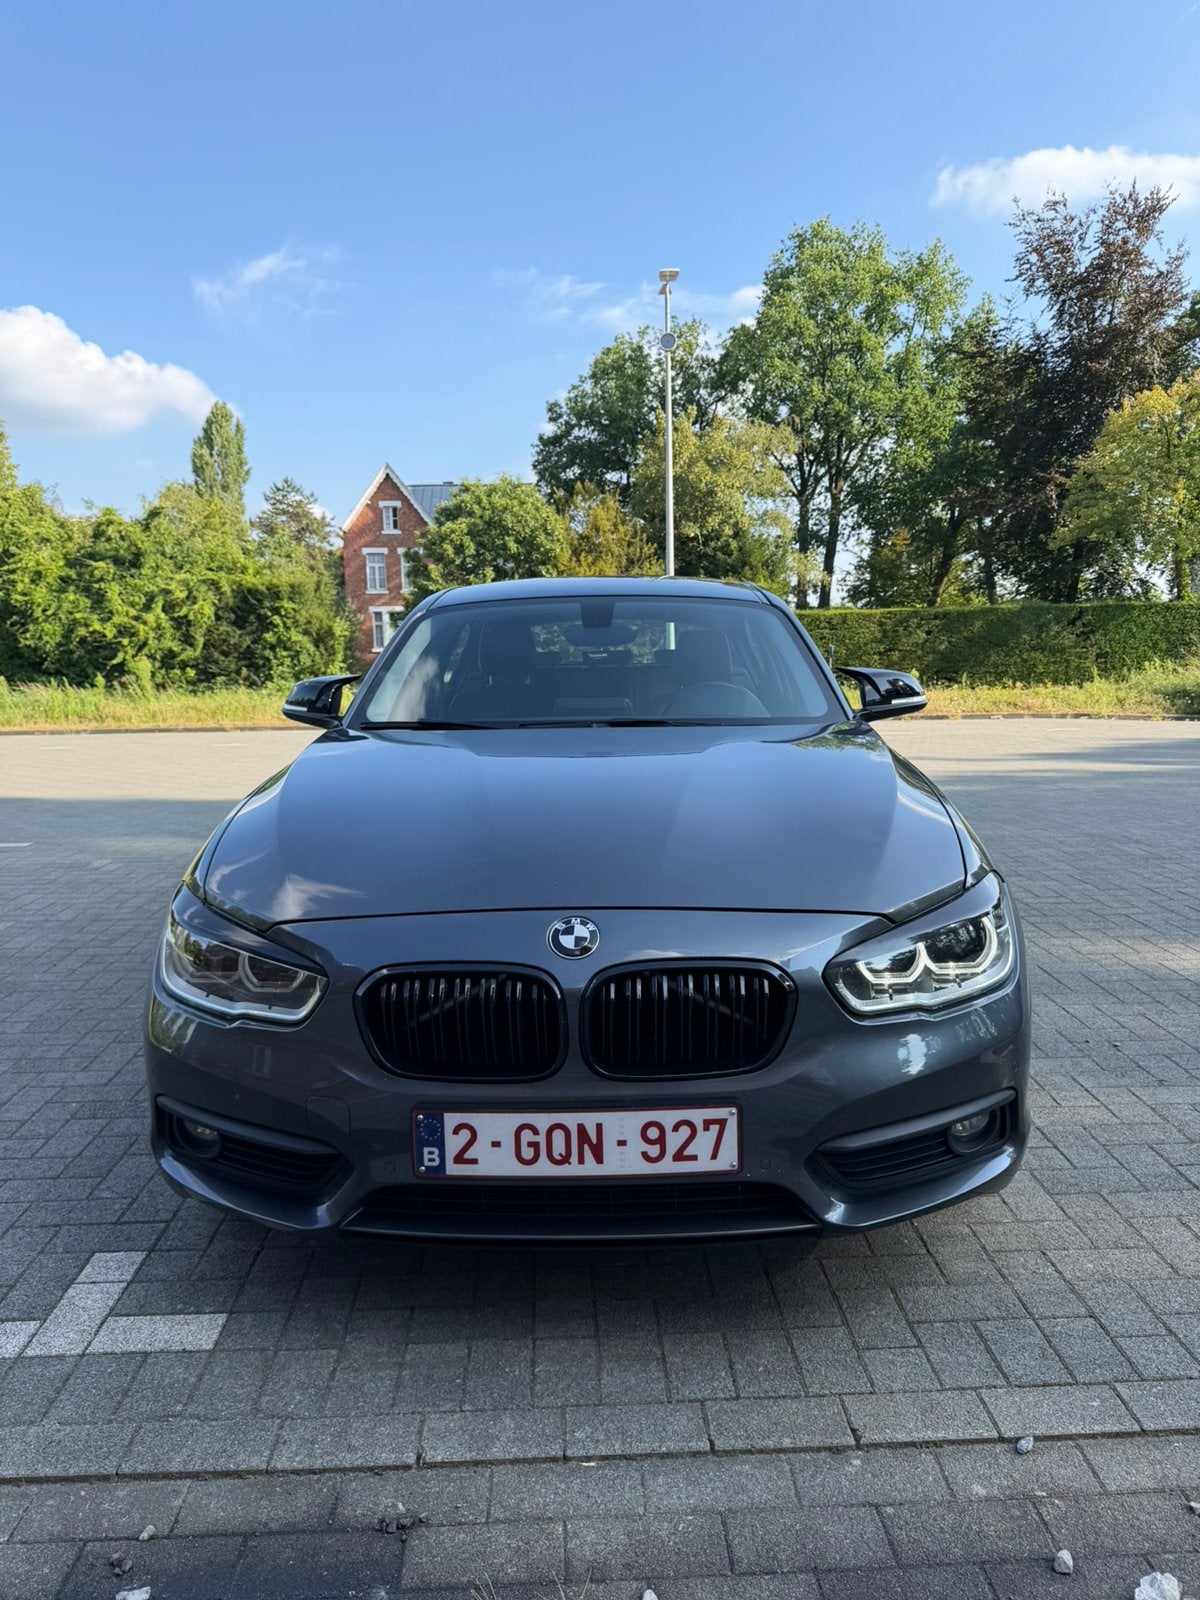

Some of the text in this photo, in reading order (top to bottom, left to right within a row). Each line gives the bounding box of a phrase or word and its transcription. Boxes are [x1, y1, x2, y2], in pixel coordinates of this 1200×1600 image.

[555, 918, 597, 931] BMW
[452, 1118, 729, 1166] 2-GQN-927
[423, 1147, 440, 1166] B
